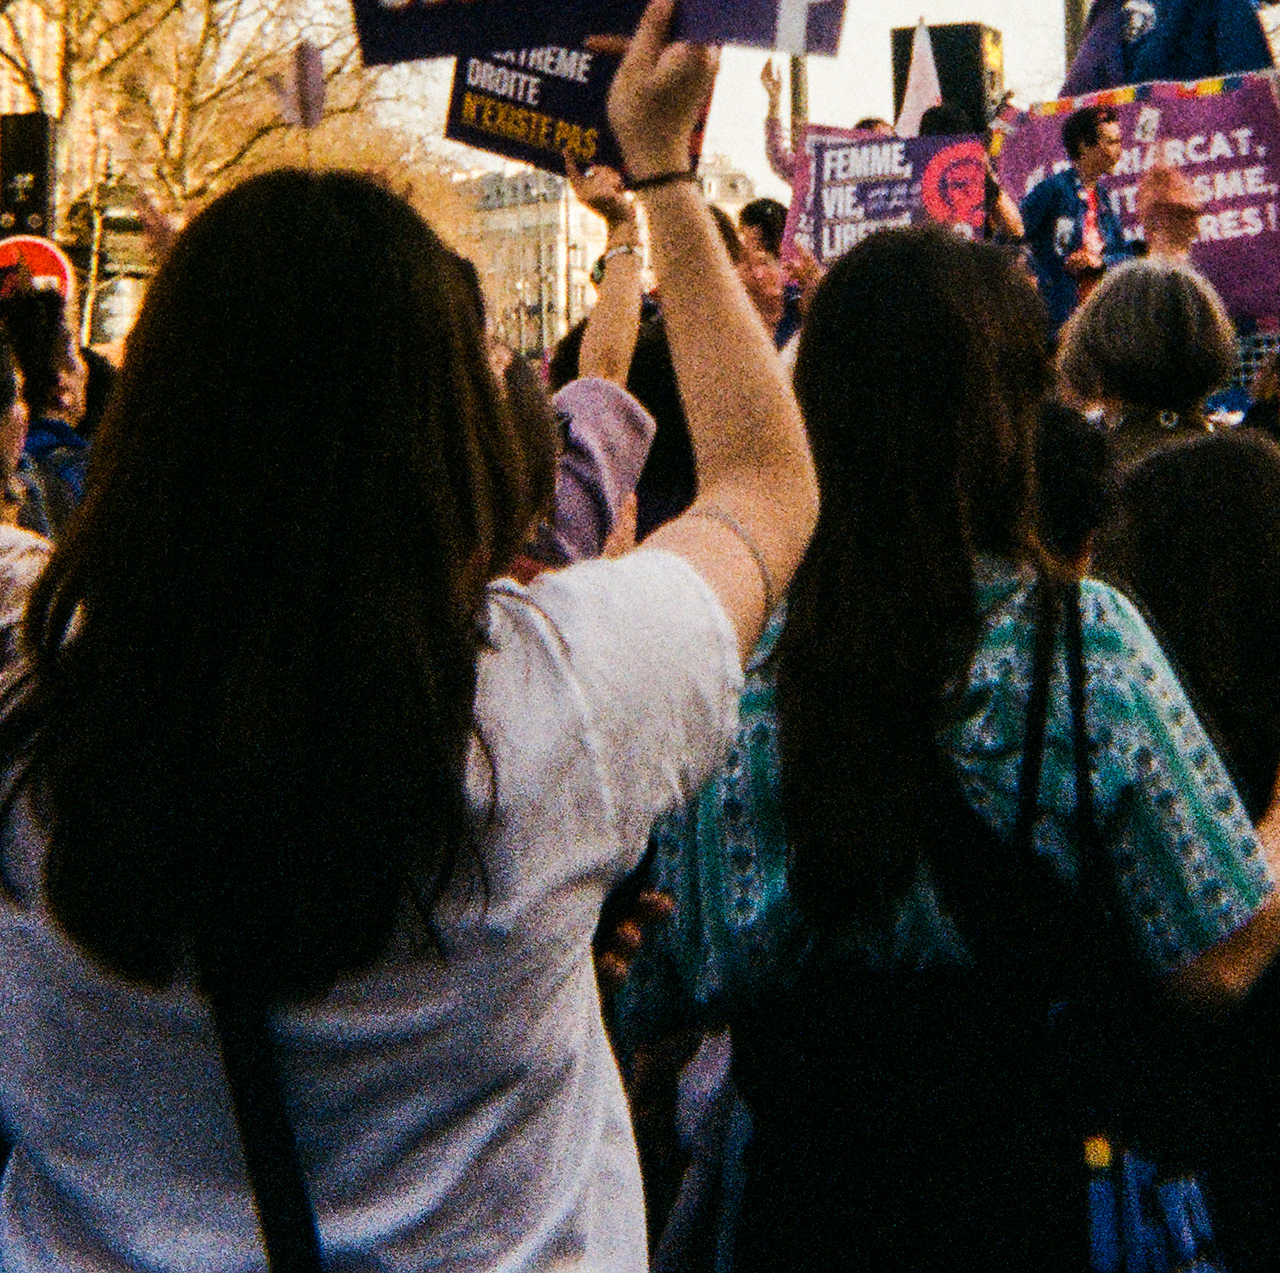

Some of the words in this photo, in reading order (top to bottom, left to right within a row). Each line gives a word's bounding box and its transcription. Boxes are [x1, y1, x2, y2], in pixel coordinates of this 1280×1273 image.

[467, 58, 541, 105] DROITE
[554, 119, 599, 162] PAS
[823, 142, 914, 182] FEMME,
[822, 185, 866, 219] VIE,
